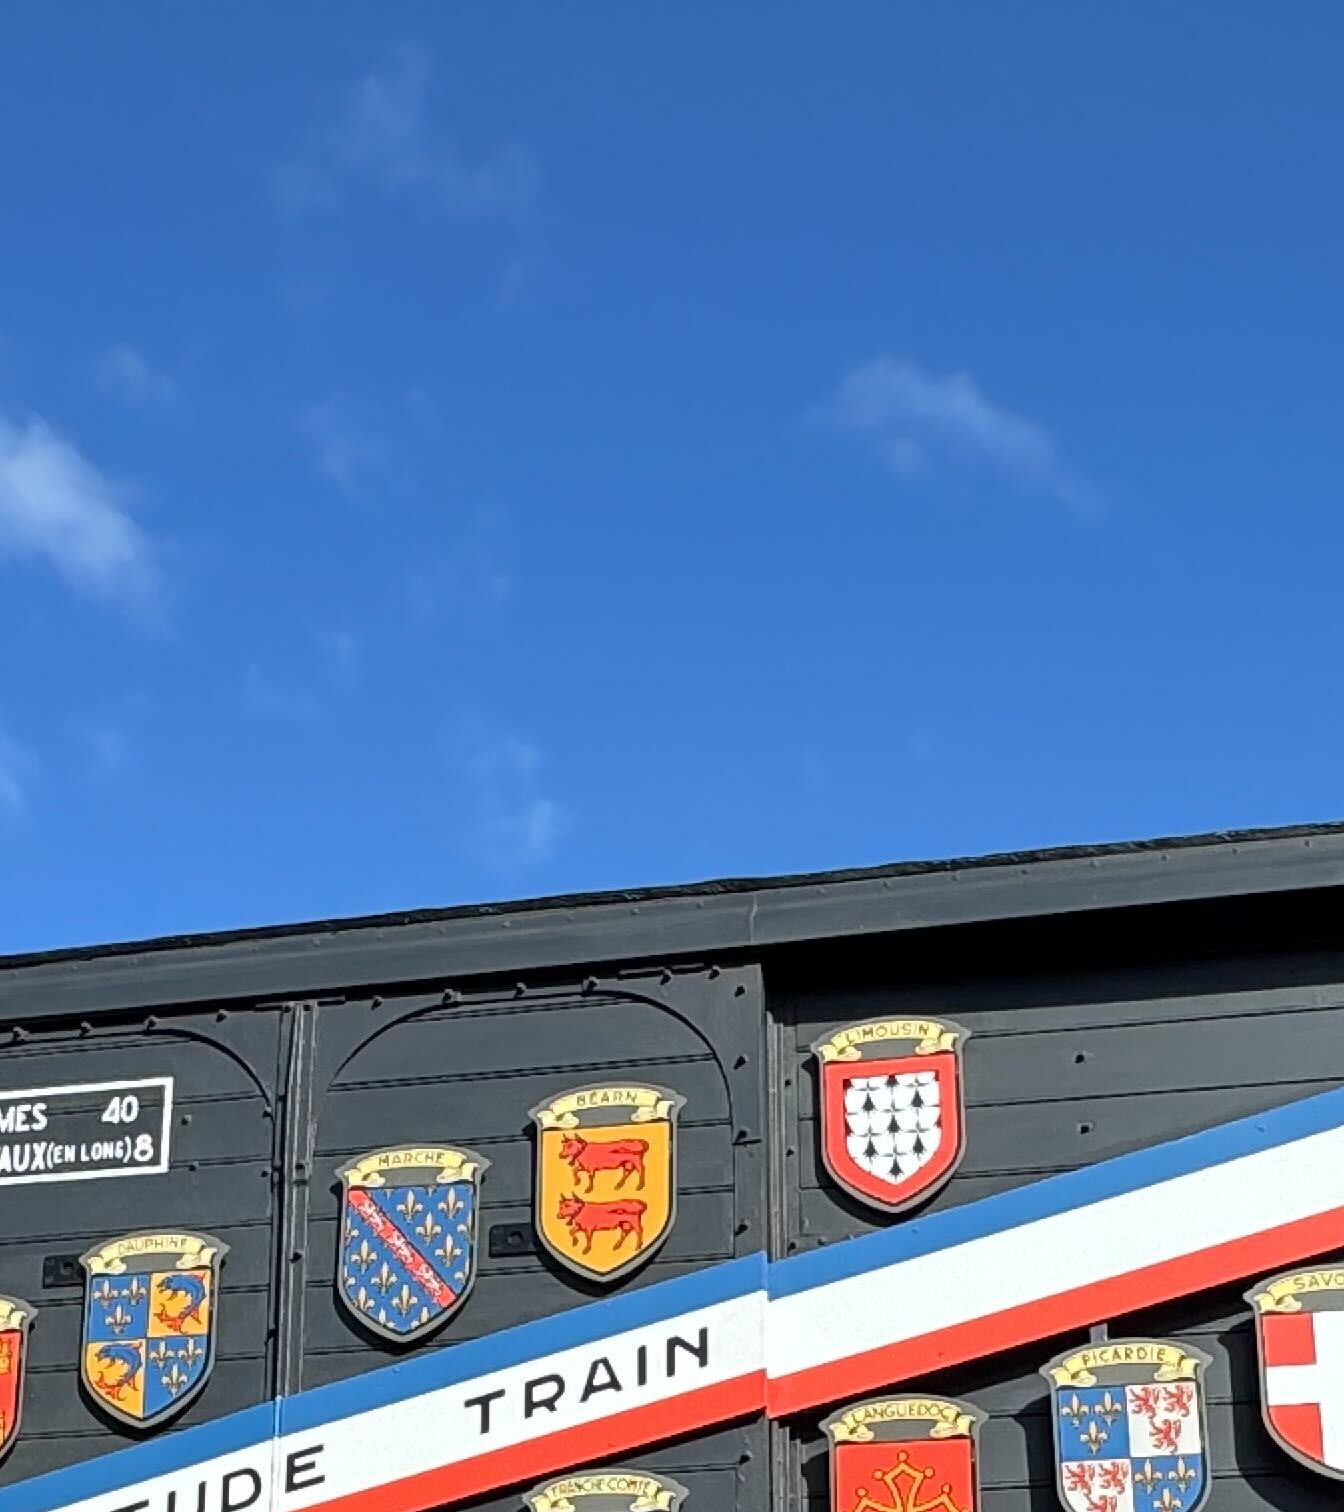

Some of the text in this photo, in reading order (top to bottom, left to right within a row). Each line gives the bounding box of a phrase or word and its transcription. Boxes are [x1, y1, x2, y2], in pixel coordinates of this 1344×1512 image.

[845, 1021, 929, 1045] LIMOUSIN
[101, 1094, 140, 1124] 40
[132, 1133, 154, 1163] 8
[378, 1151, 445, 1168] MARCHE
[1082, 1347, 1165, 1368] PICARDIE
[463, 1326, 709, 1435] TRAIN
[850, 1402, 953, 1424] LANGUEDOC
